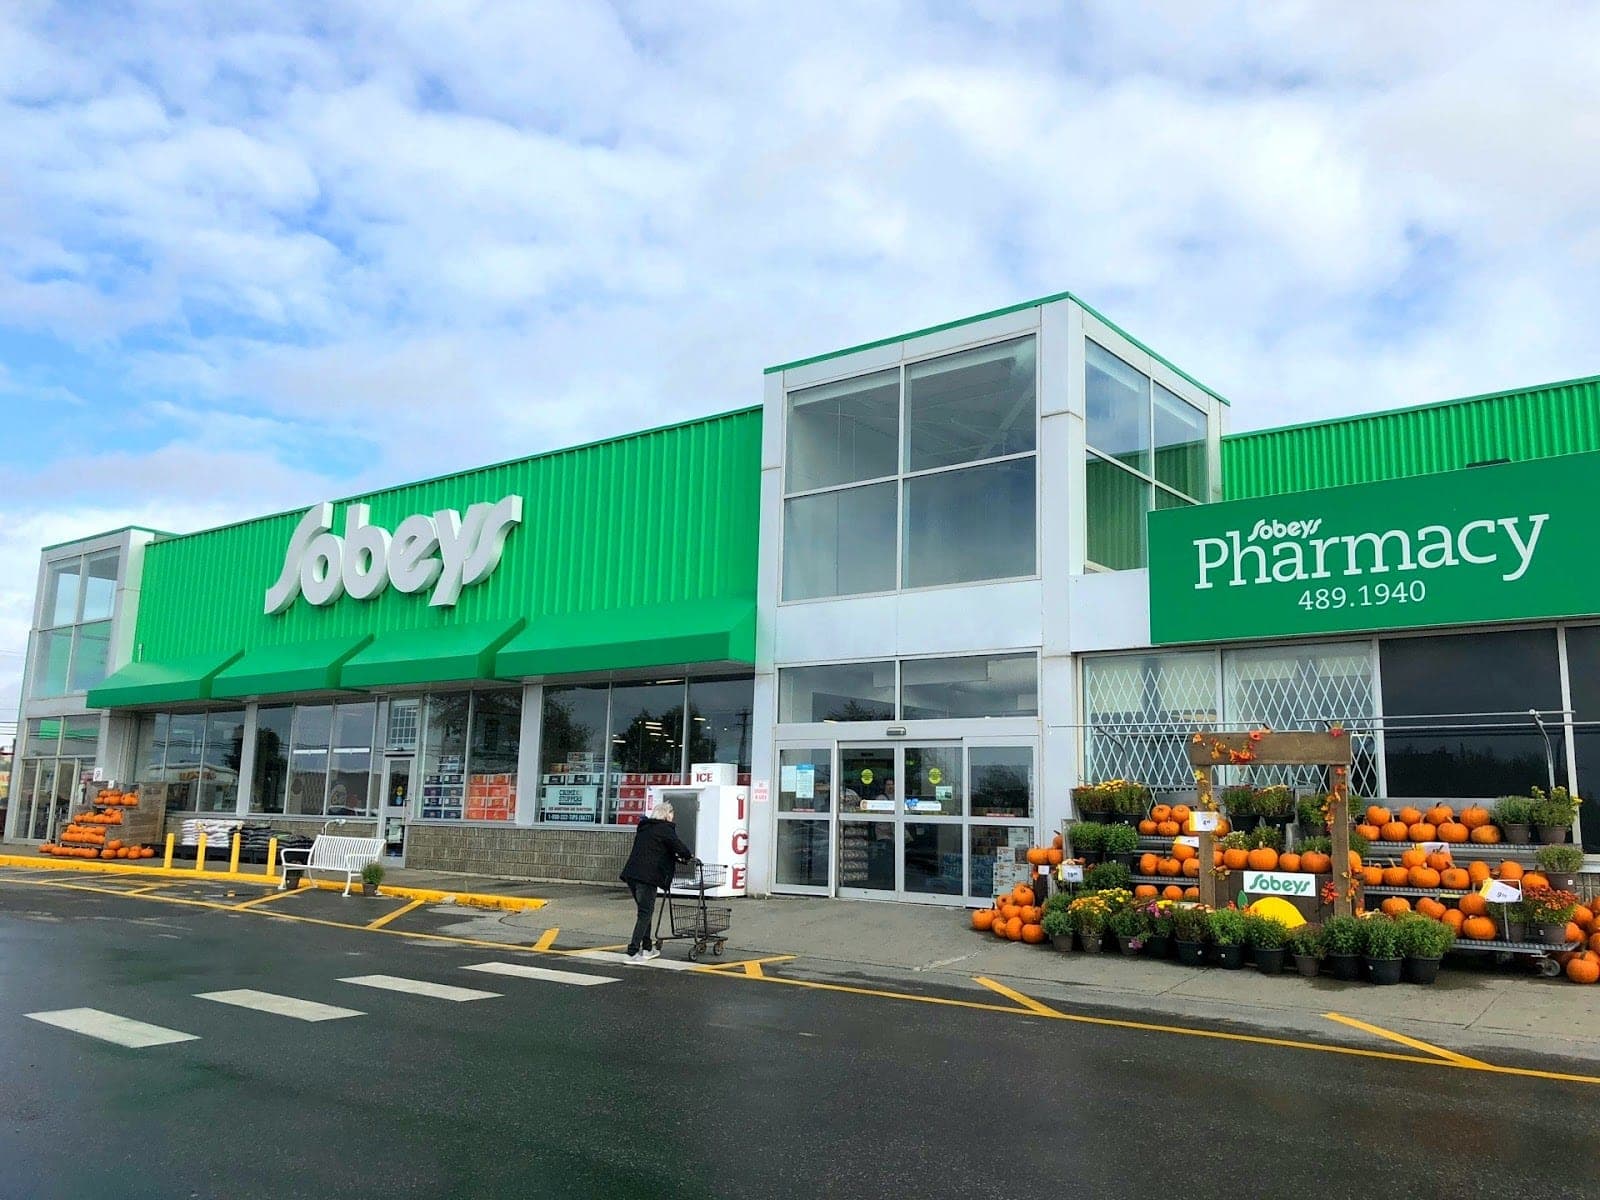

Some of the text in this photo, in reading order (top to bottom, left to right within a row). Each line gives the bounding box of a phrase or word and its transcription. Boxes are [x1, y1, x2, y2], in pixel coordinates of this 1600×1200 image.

[1247, 518, 1322, 542] Sobeys
[264, 494, 523, 614] Sobeys
[1193, 513, 1550, 590] Pharmacy
[1298, 579, 1426, 611] 489.1940
[696, 772, 713, 783] ICE
[731, 794, 748, 889] ICE
[1249, 873, 1311, 895] Sobeys
